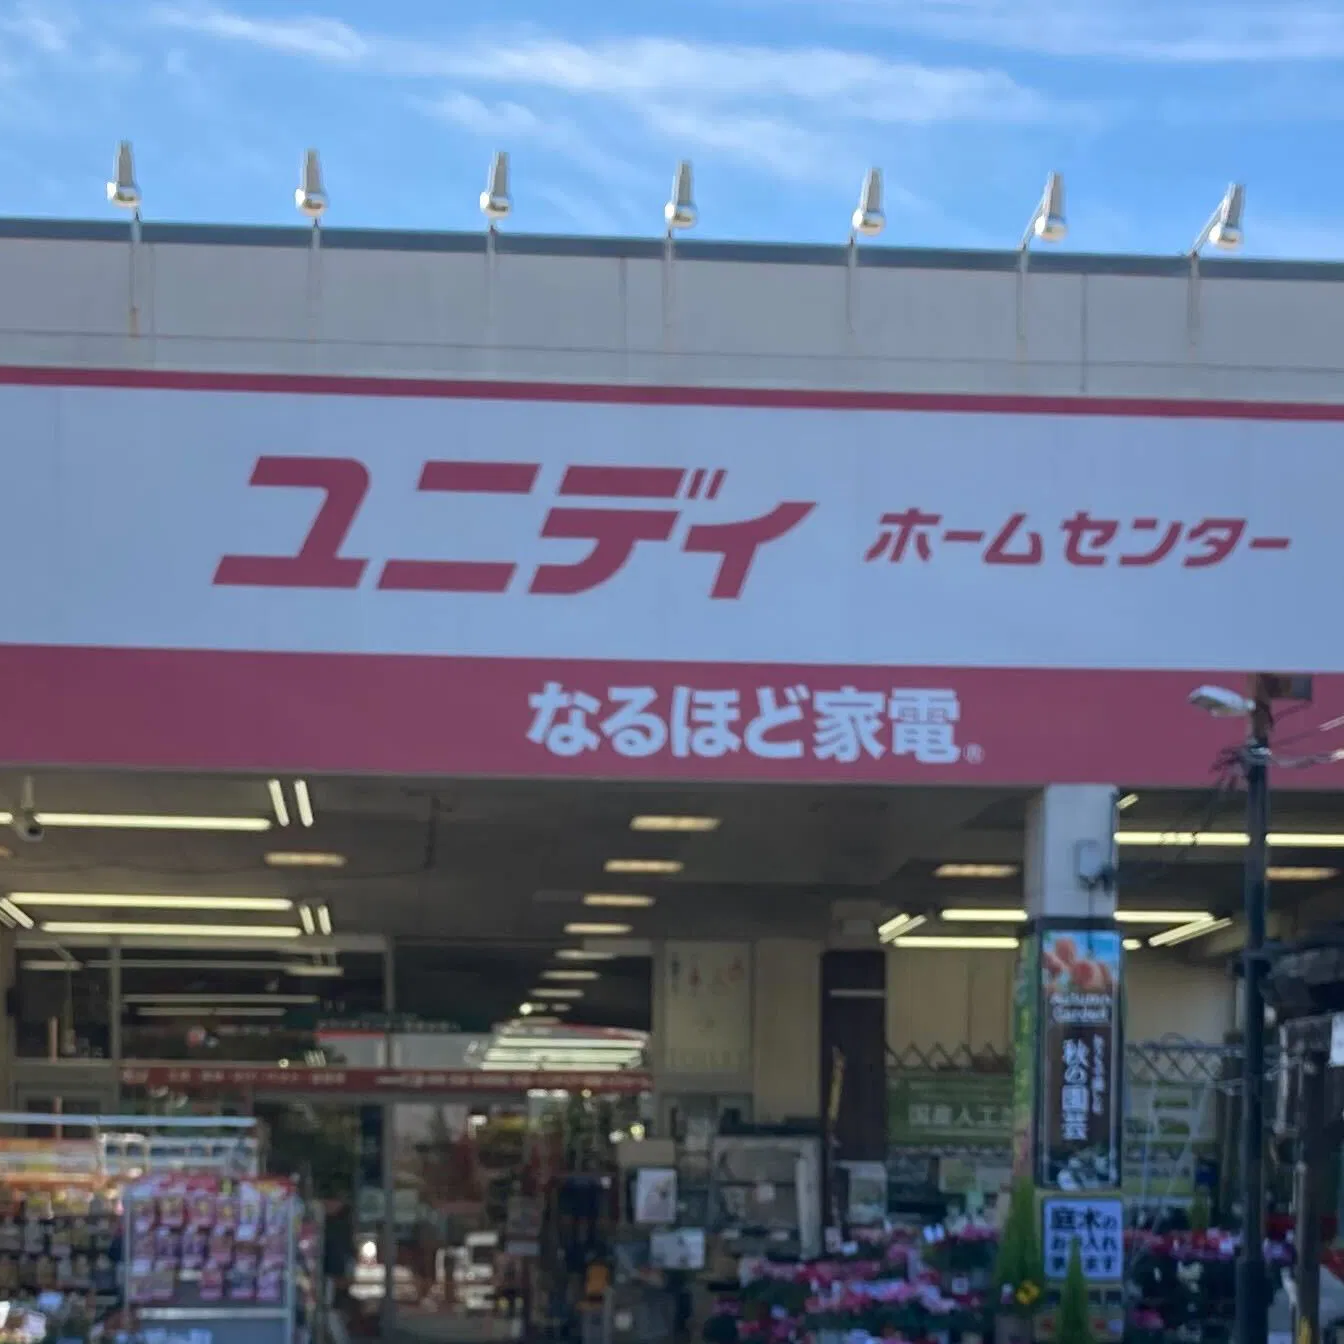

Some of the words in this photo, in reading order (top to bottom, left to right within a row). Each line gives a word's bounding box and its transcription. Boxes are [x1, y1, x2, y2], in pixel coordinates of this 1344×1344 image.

[211, 455, 818, 600] ユニディ
[863, 507, 1291, 569] ホームセンター
[527, 681, 961, 765] なるほど家電
